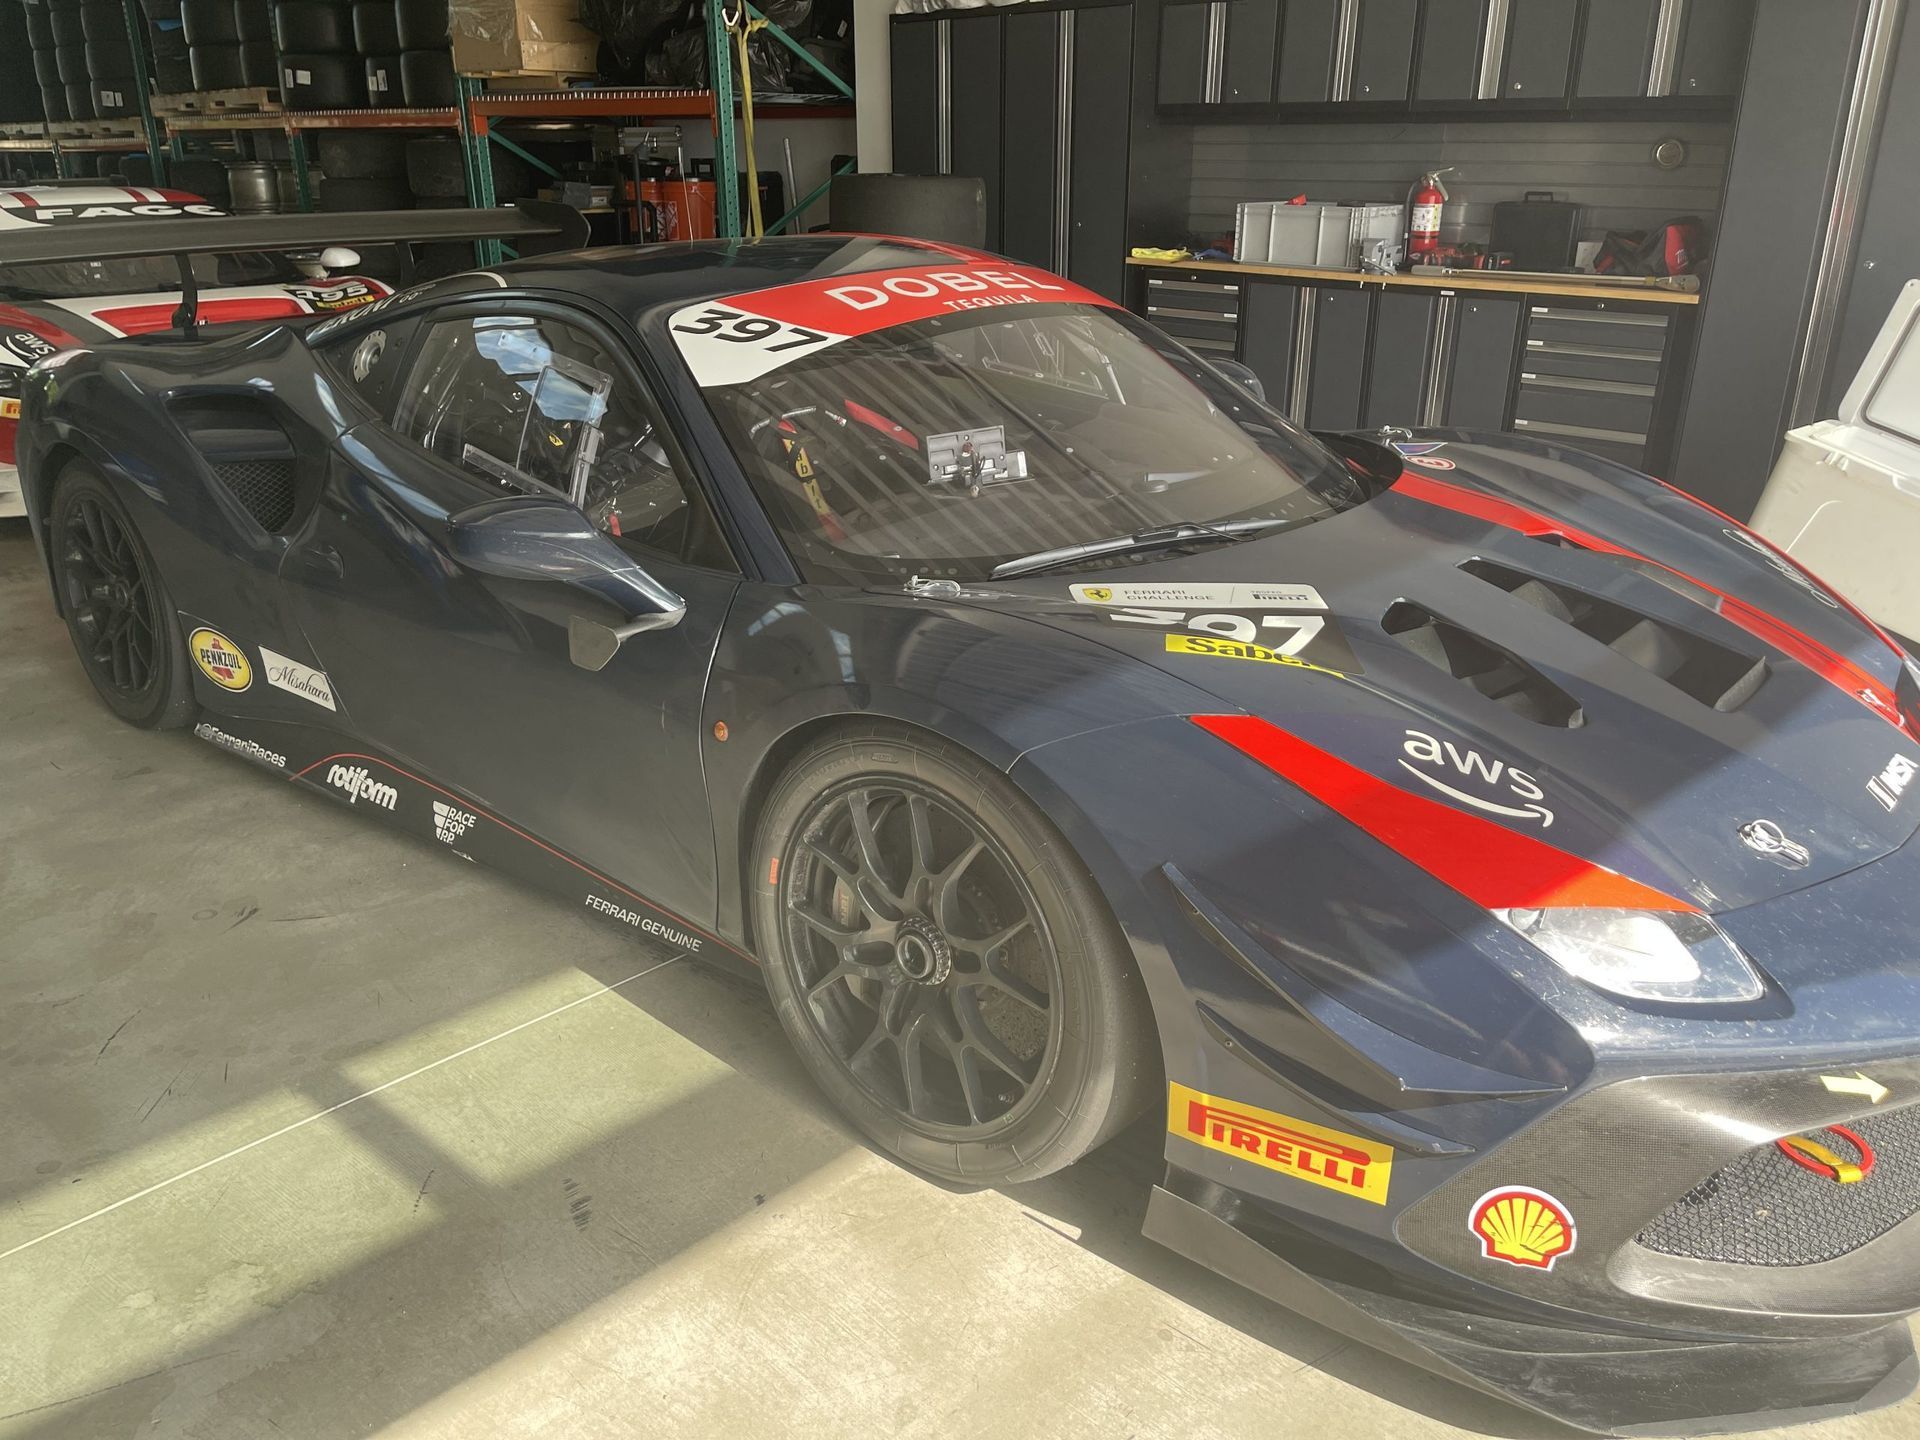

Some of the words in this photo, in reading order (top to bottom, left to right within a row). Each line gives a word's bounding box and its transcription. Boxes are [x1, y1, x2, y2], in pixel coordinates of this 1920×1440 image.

[824, 271, 1064, 311] DOBEL
[943, 293, 1040, 311] TEQUILA
[15, 333, 56, 355] aws
[672, 308, 829, 353] 397
[200, 648, 242, 670] PENNZOIL
[1186, 638, 1312, 667] Sabe
[268, 666, 331, 702] Misahara
[1403, 730, 1544, 801] aws
[326, 764, 398, 811] rotiform
[444, 819, 466, 836] FOR
[448, 807, 477, 828] RACE
[585, 894, 641, 927] FERRARI
[641, 918, 703, 953] GENUINE
[1187, 1100, 1372, 1189] PIRELLI
